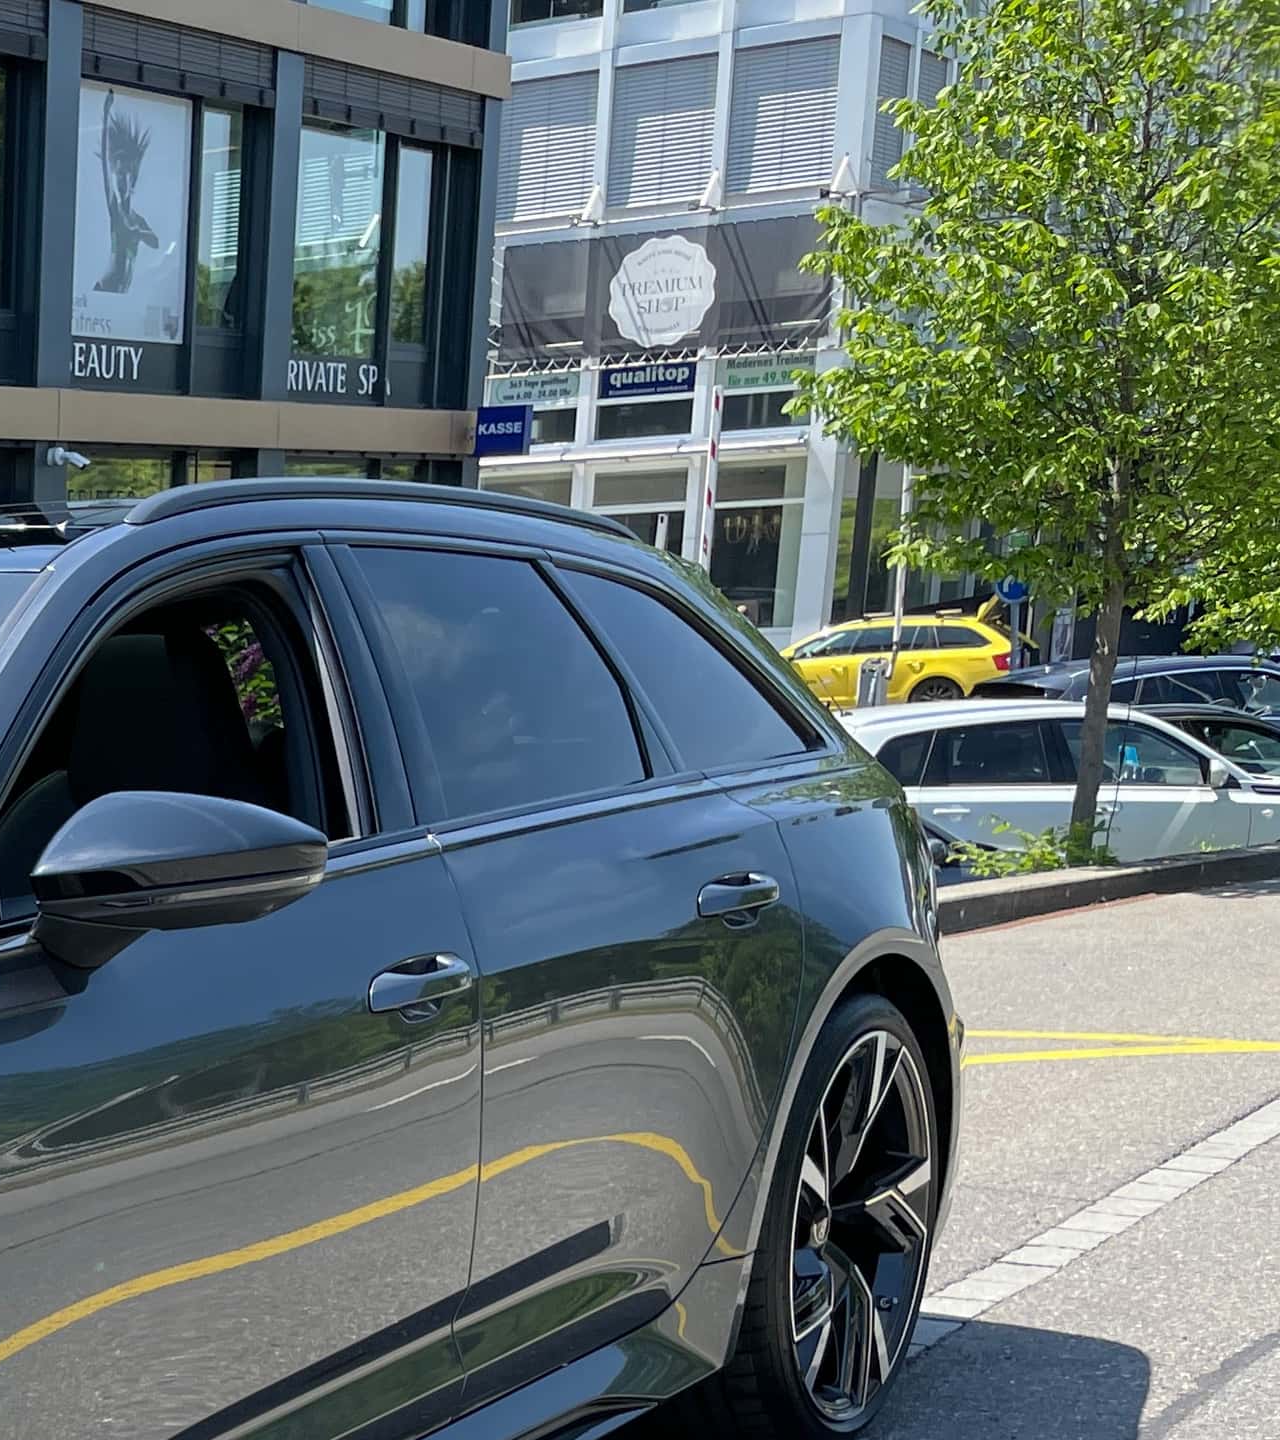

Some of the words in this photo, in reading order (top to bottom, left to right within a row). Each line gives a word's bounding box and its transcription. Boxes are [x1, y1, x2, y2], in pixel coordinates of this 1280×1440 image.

[69, 342, 144, 380] EAUTY
[609, 365, 690, 389] qualitop
[478, 422, 523, 436] KASSE
